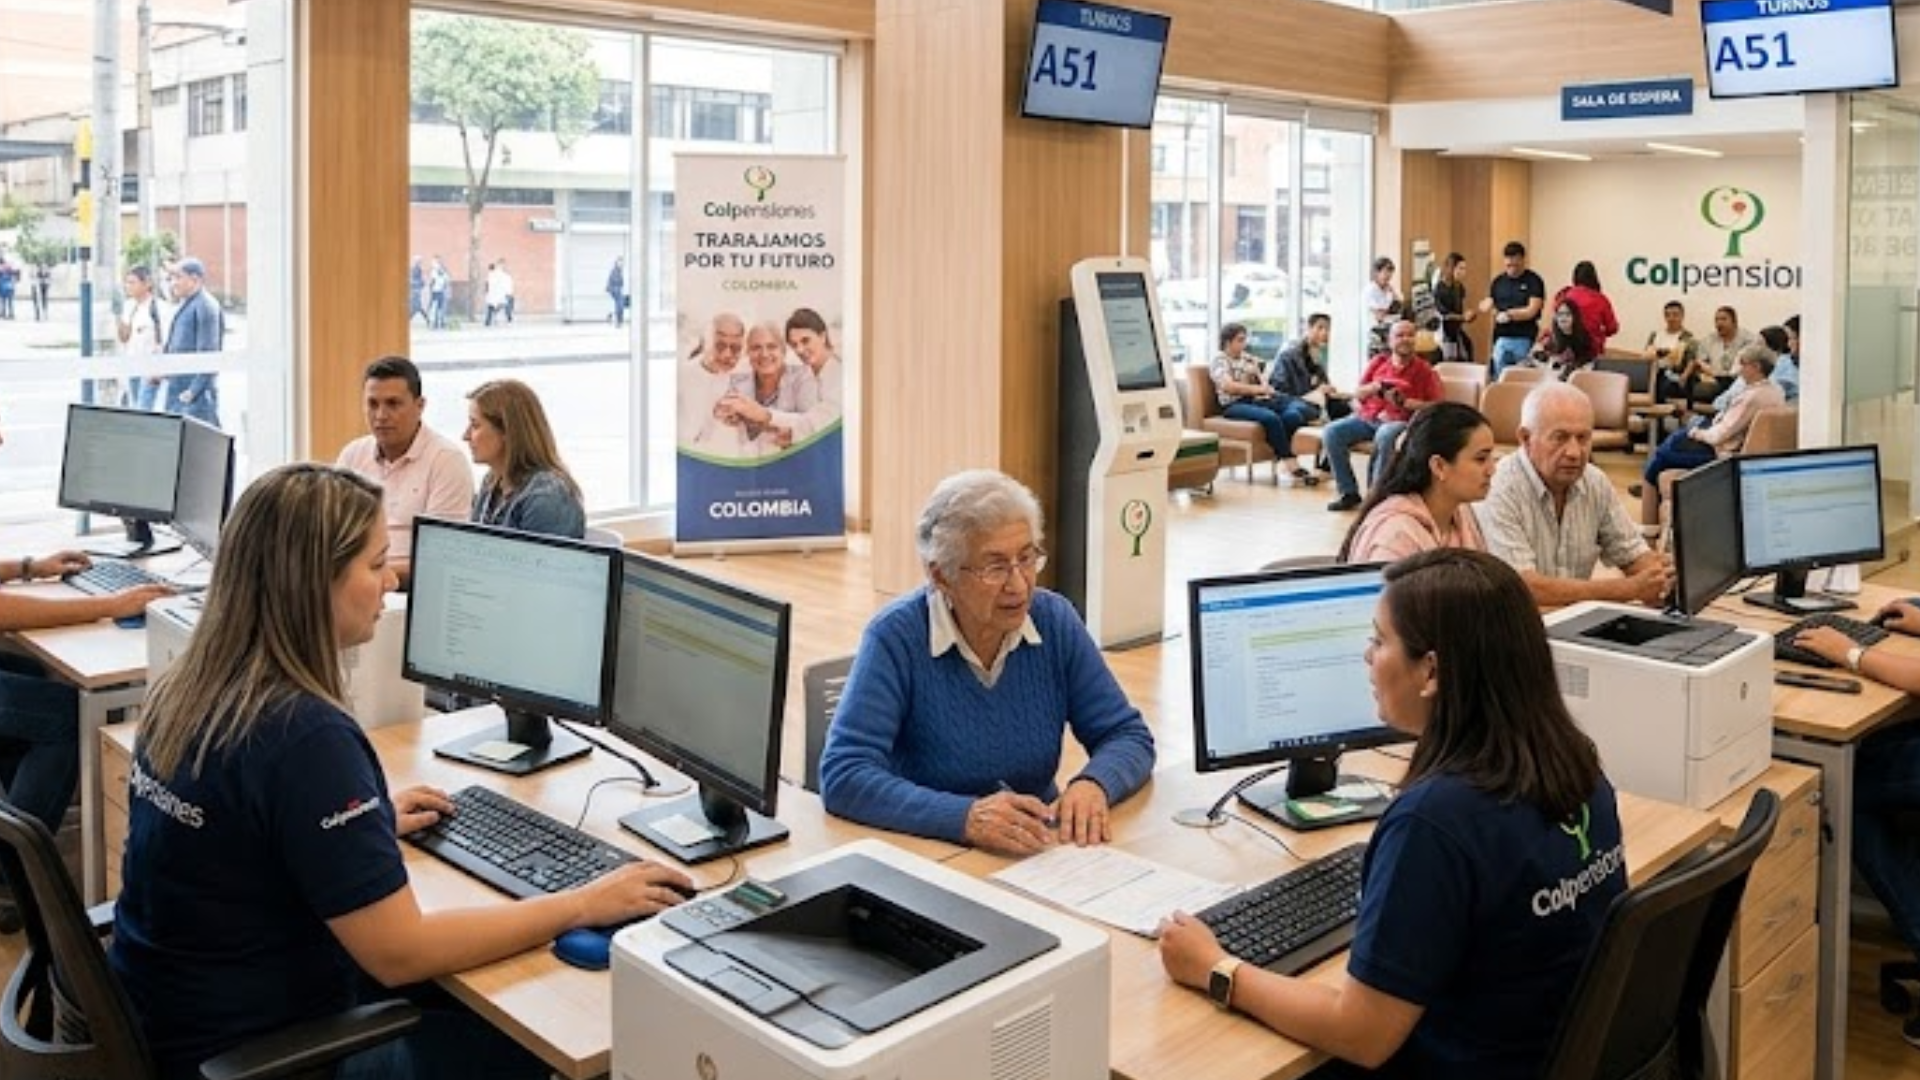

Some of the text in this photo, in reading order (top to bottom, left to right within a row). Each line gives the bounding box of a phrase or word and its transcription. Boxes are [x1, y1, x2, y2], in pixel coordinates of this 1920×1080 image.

[1714, 31, 1796, 72] A51
[1034, 44, 1098, 91] A51
[684, 253, 834, 269] POR TU FUTURO
[709, 500, 812, 518] COLOMBIA
